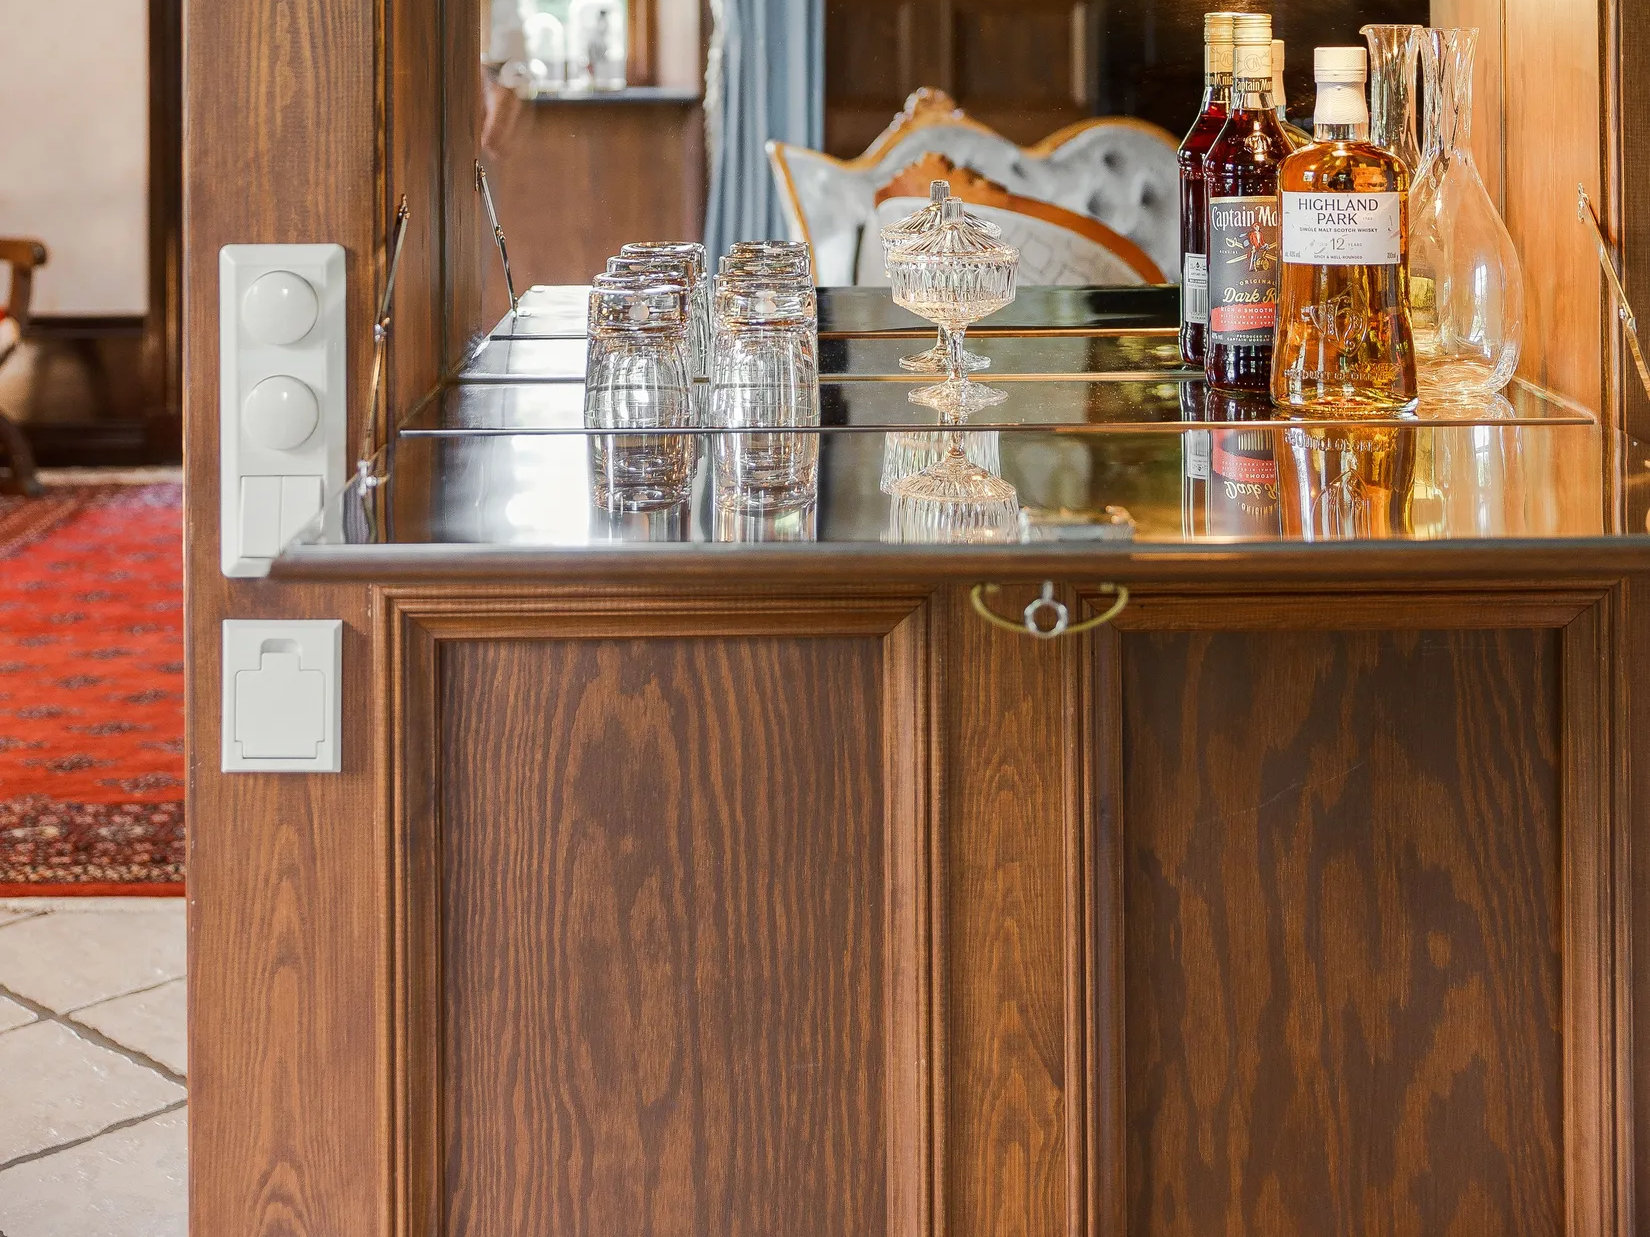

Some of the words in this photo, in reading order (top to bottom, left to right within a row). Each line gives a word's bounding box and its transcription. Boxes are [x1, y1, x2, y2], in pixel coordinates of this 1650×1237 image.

[1298, 198, 1378, 211] HIGHLAND
[1317, 213, 1357, 225] PARK
[1330, 238, 1344, 250] 12
[1223, 287, 1259, 302] Dark
